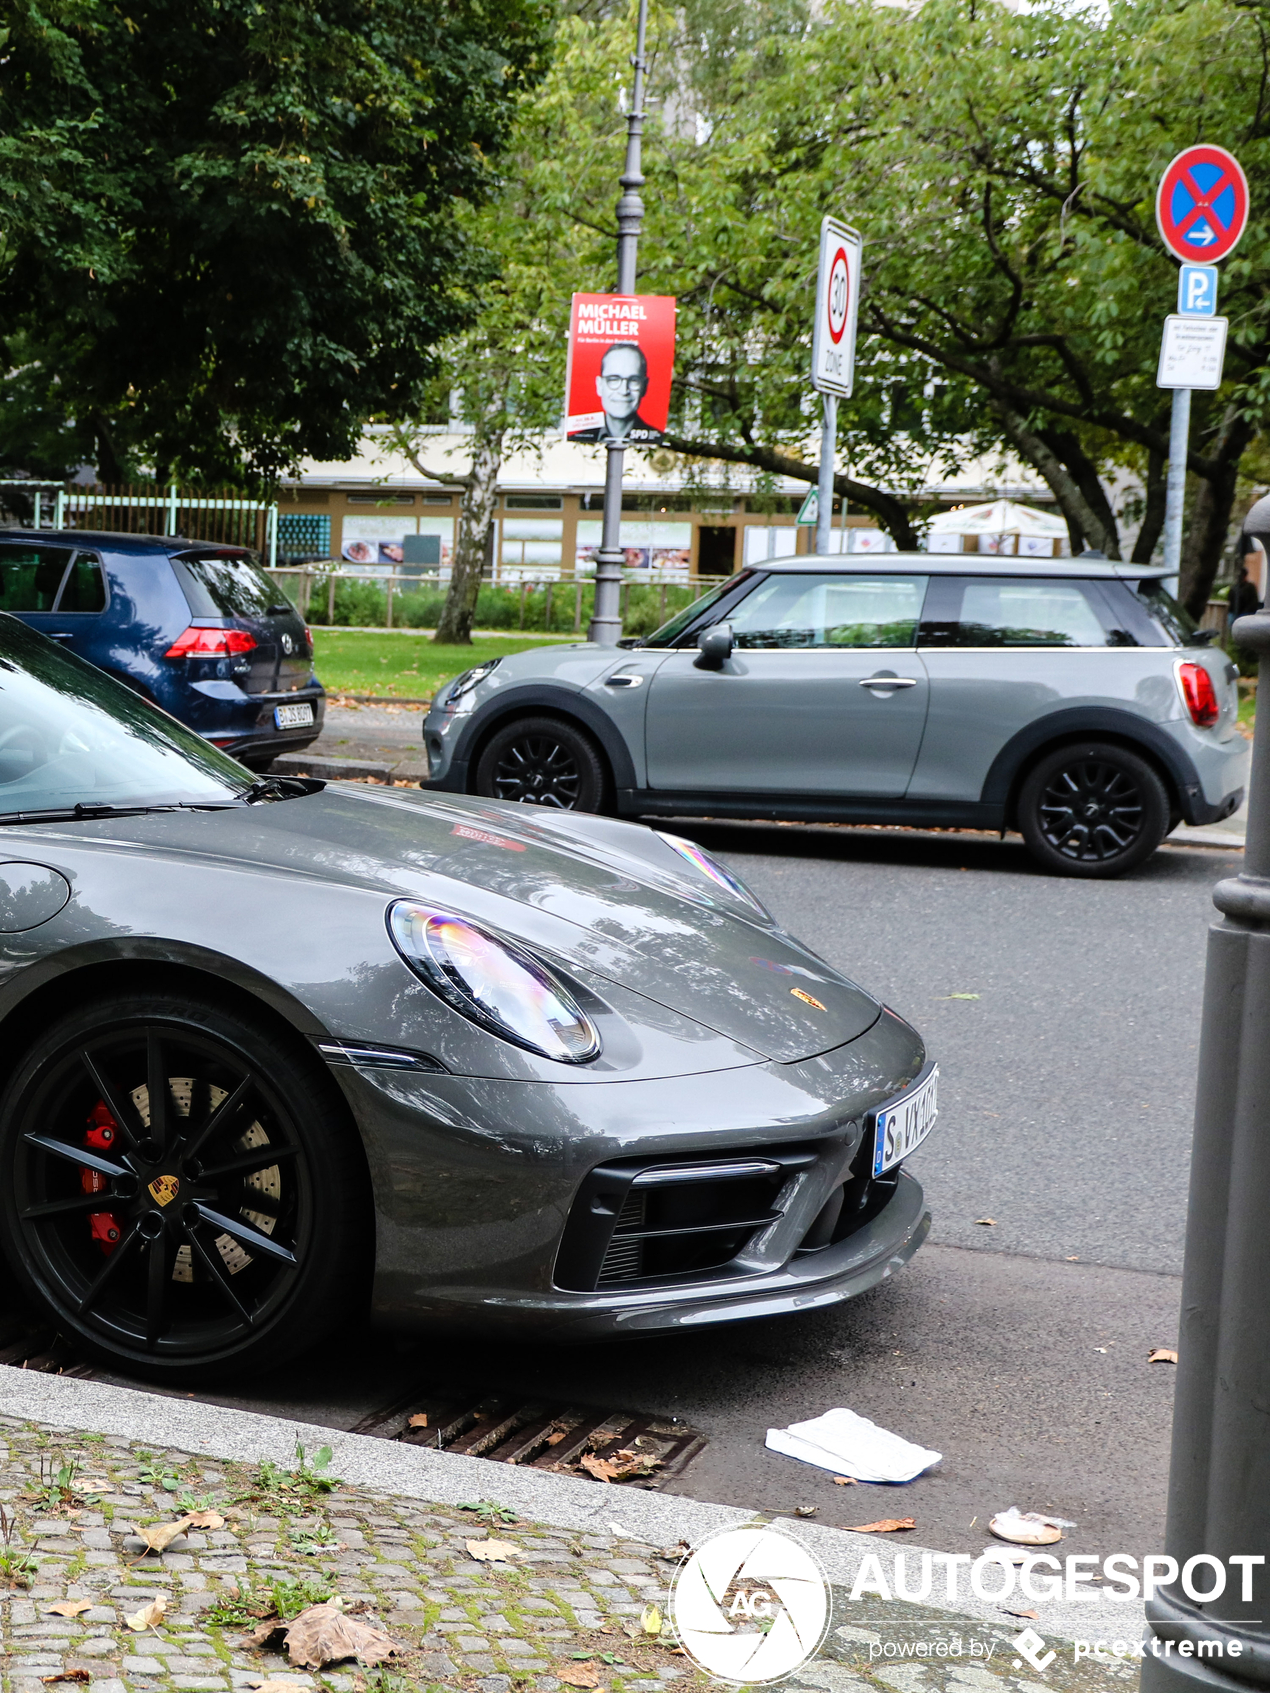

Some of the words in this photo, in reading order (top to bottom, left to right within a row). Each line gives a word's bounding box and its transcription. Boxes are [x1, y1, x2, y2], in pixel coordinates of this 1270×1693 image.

[832, 272, 846, 318] 30
[1187, 271, 1209, 309] P
[578, 303, 647, 320] MICHAEL
[577, 317, 639, 336] MÜLLER
[825, 350, 842, 376] ZONE
[630, 428, 649, 440] SPD
[884, 1114, 897, 1162] S
